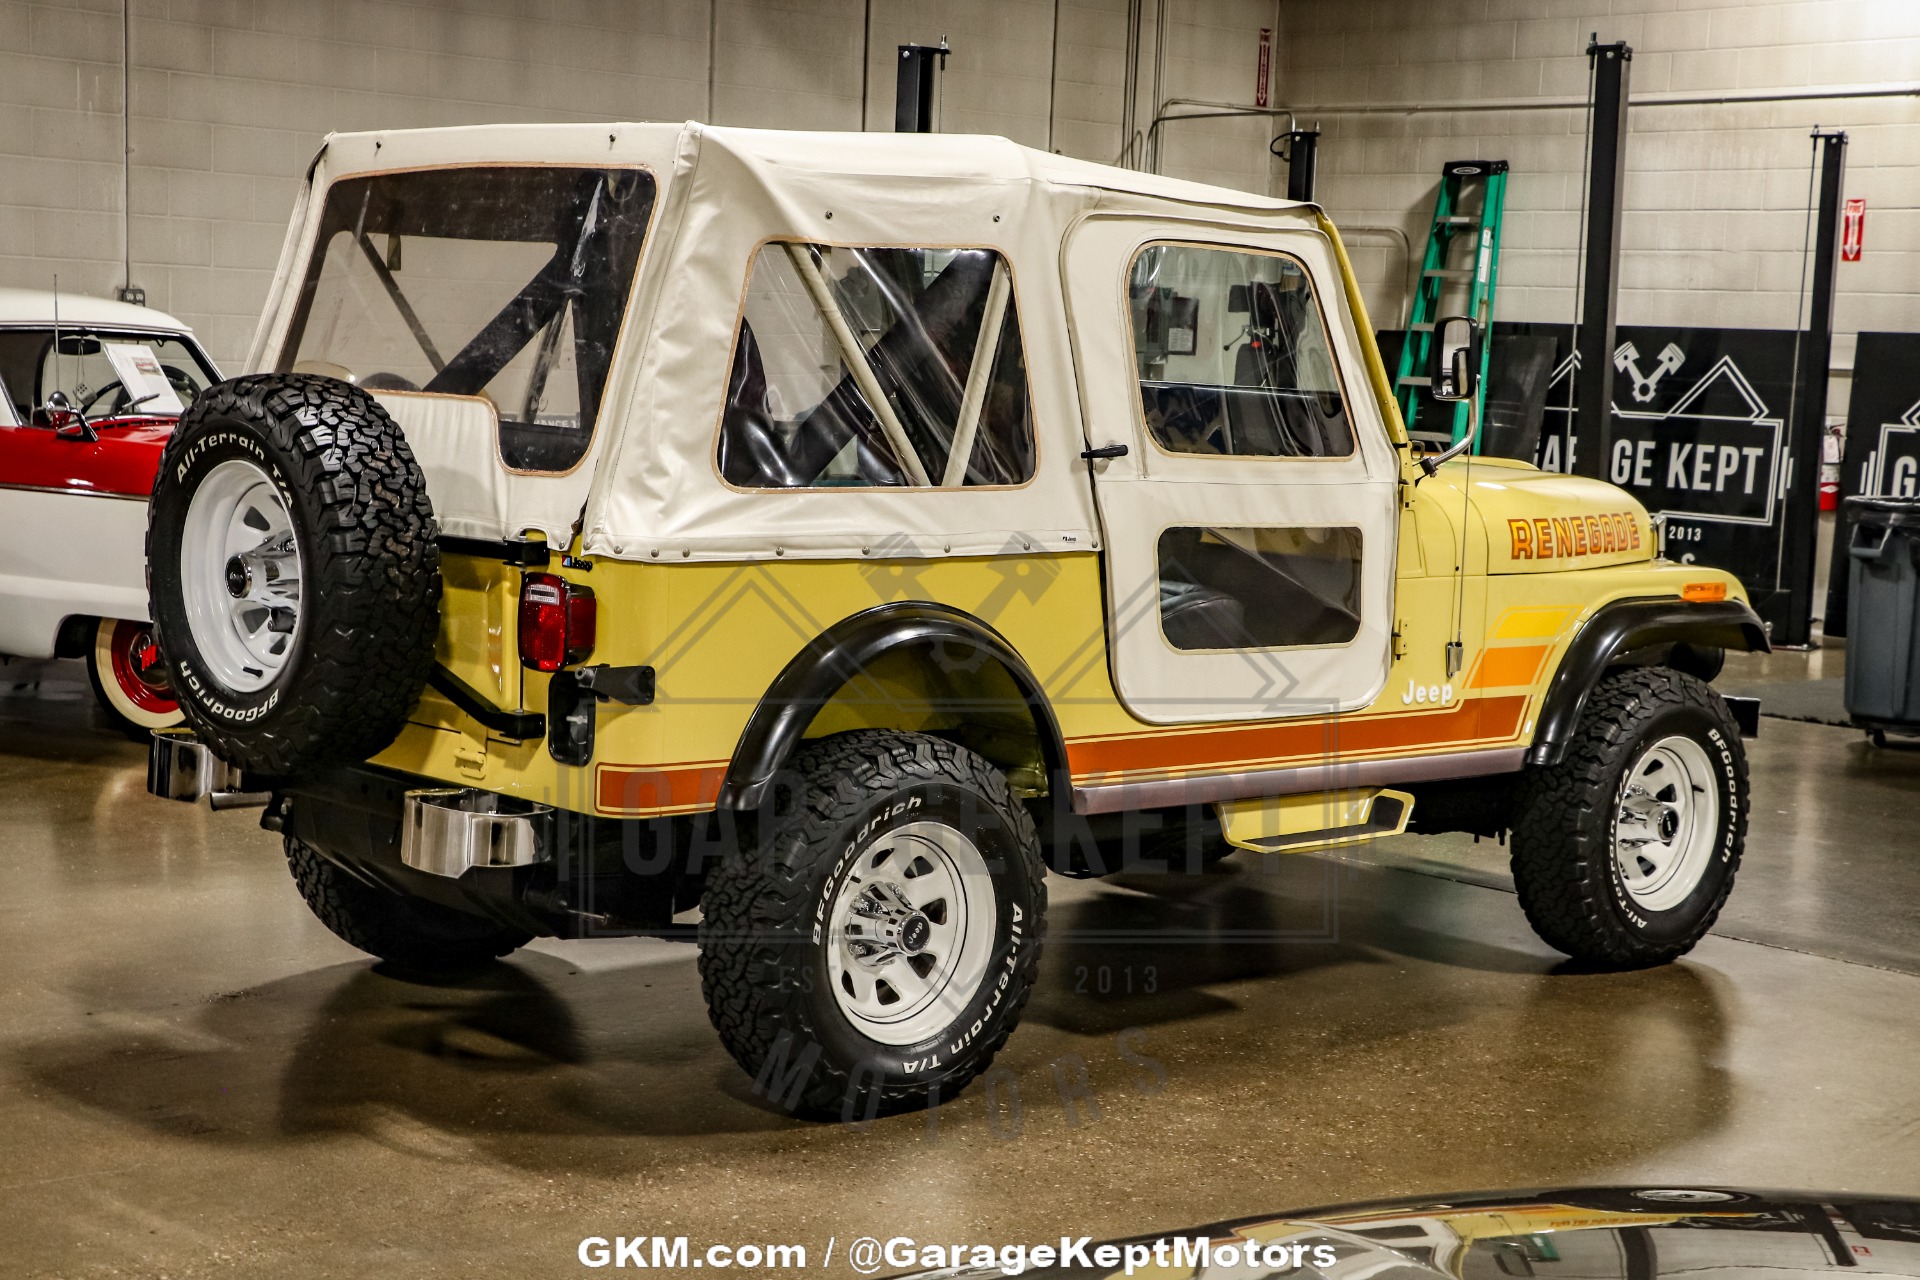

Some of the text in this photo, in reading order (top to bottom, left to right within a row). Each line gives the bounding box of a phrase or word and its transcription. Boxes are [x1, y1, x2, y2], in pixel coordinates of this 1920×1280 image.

[177, 432, 265, 484] All-Terrain
[1667, 442, 1764, 494] KEPT
[1507, 512, 1640, 560] RENEGADE
[1668, 525, 1702, 541] 2013
[180, 661, 279, 722] BFGoodrich
[1402, 680, 1453, 706] Jeep
[1707, 728, 1739, 864] BFGoodrich
[812, 796, 922, 946] BFGoodrich
[908, 921, 924, 945] Jeep
[902, 902, 1023, 1074] All-Terrain T/A
